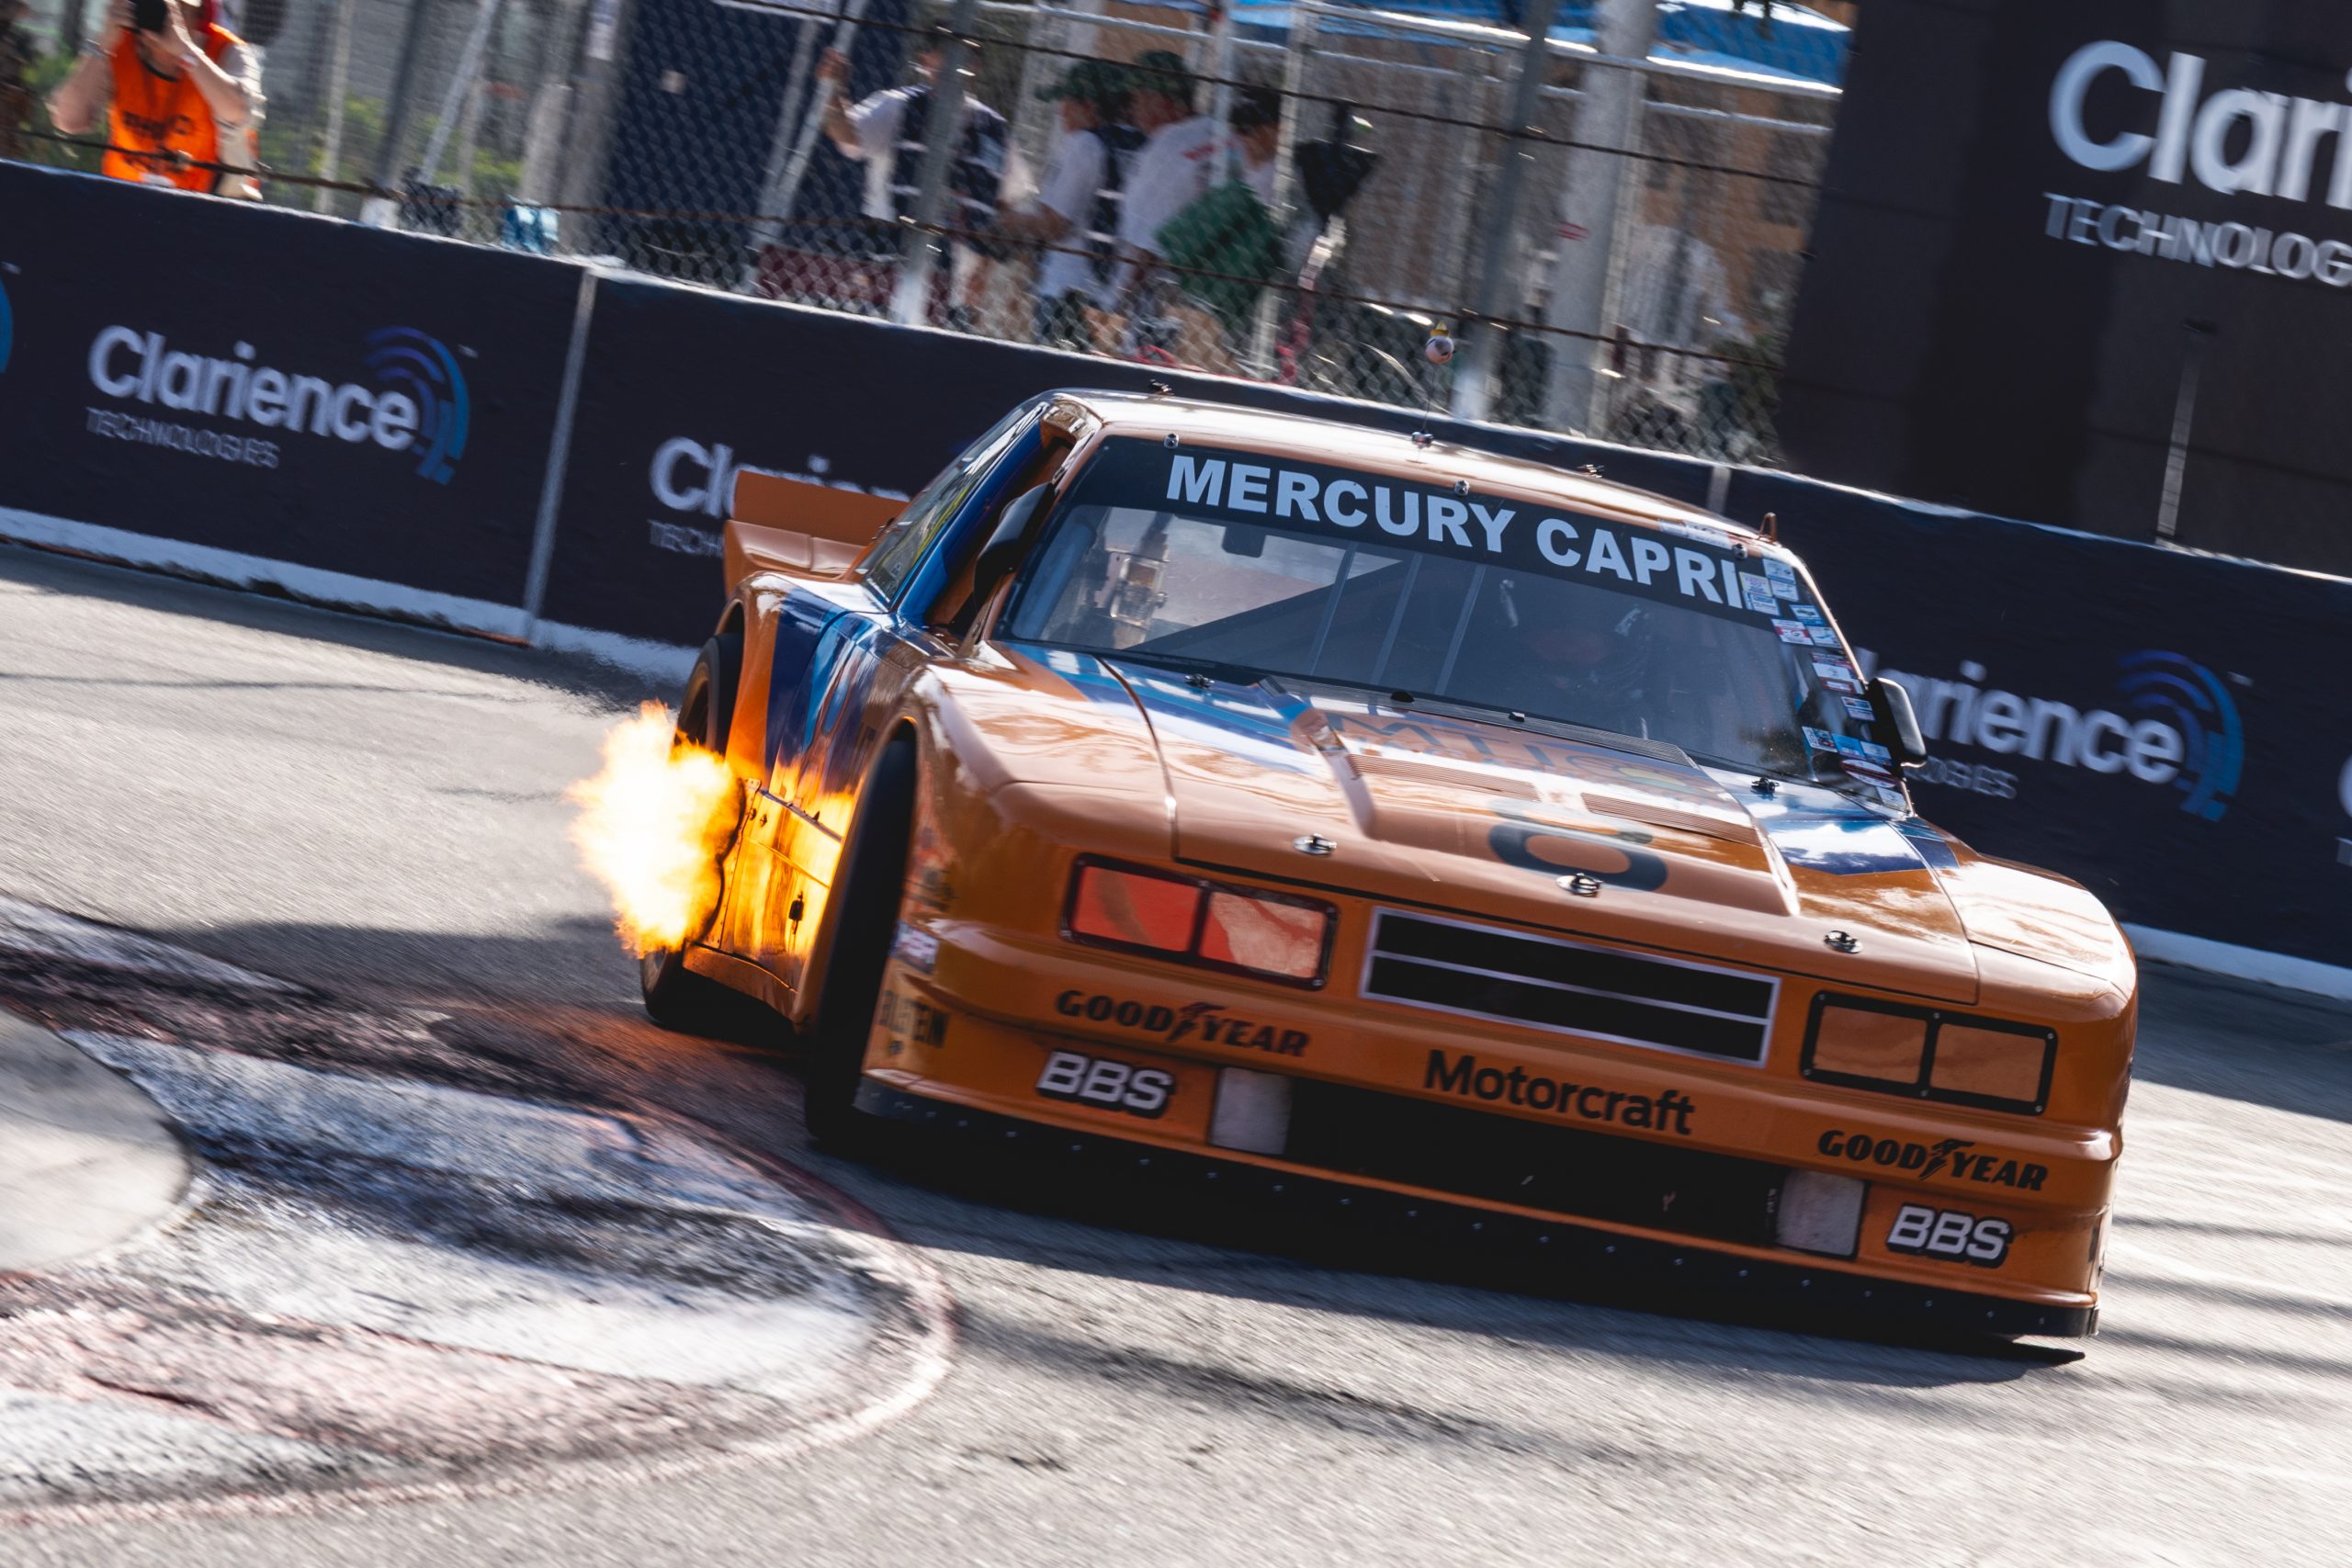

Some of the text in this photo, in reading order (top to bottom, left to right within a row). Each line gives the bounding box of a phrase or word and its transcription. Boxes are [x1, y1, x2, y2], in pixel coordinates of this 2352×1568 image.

[87, 324, 420, 451] Clarience
[1166, 455, 1516, 553] MERCURY
[1535, 518, 1743, 609] CAPRI
[1055, 989, 1310, 1057] GOODYEAR
[1037, 1051, 1173, 1112] BBS
[1423, 1048, 1695, 1136] Motorcraft
[1817, 1130, 2049, 1192] GOODYEAR
[1889, 1202, 2010, 1262] BBS
